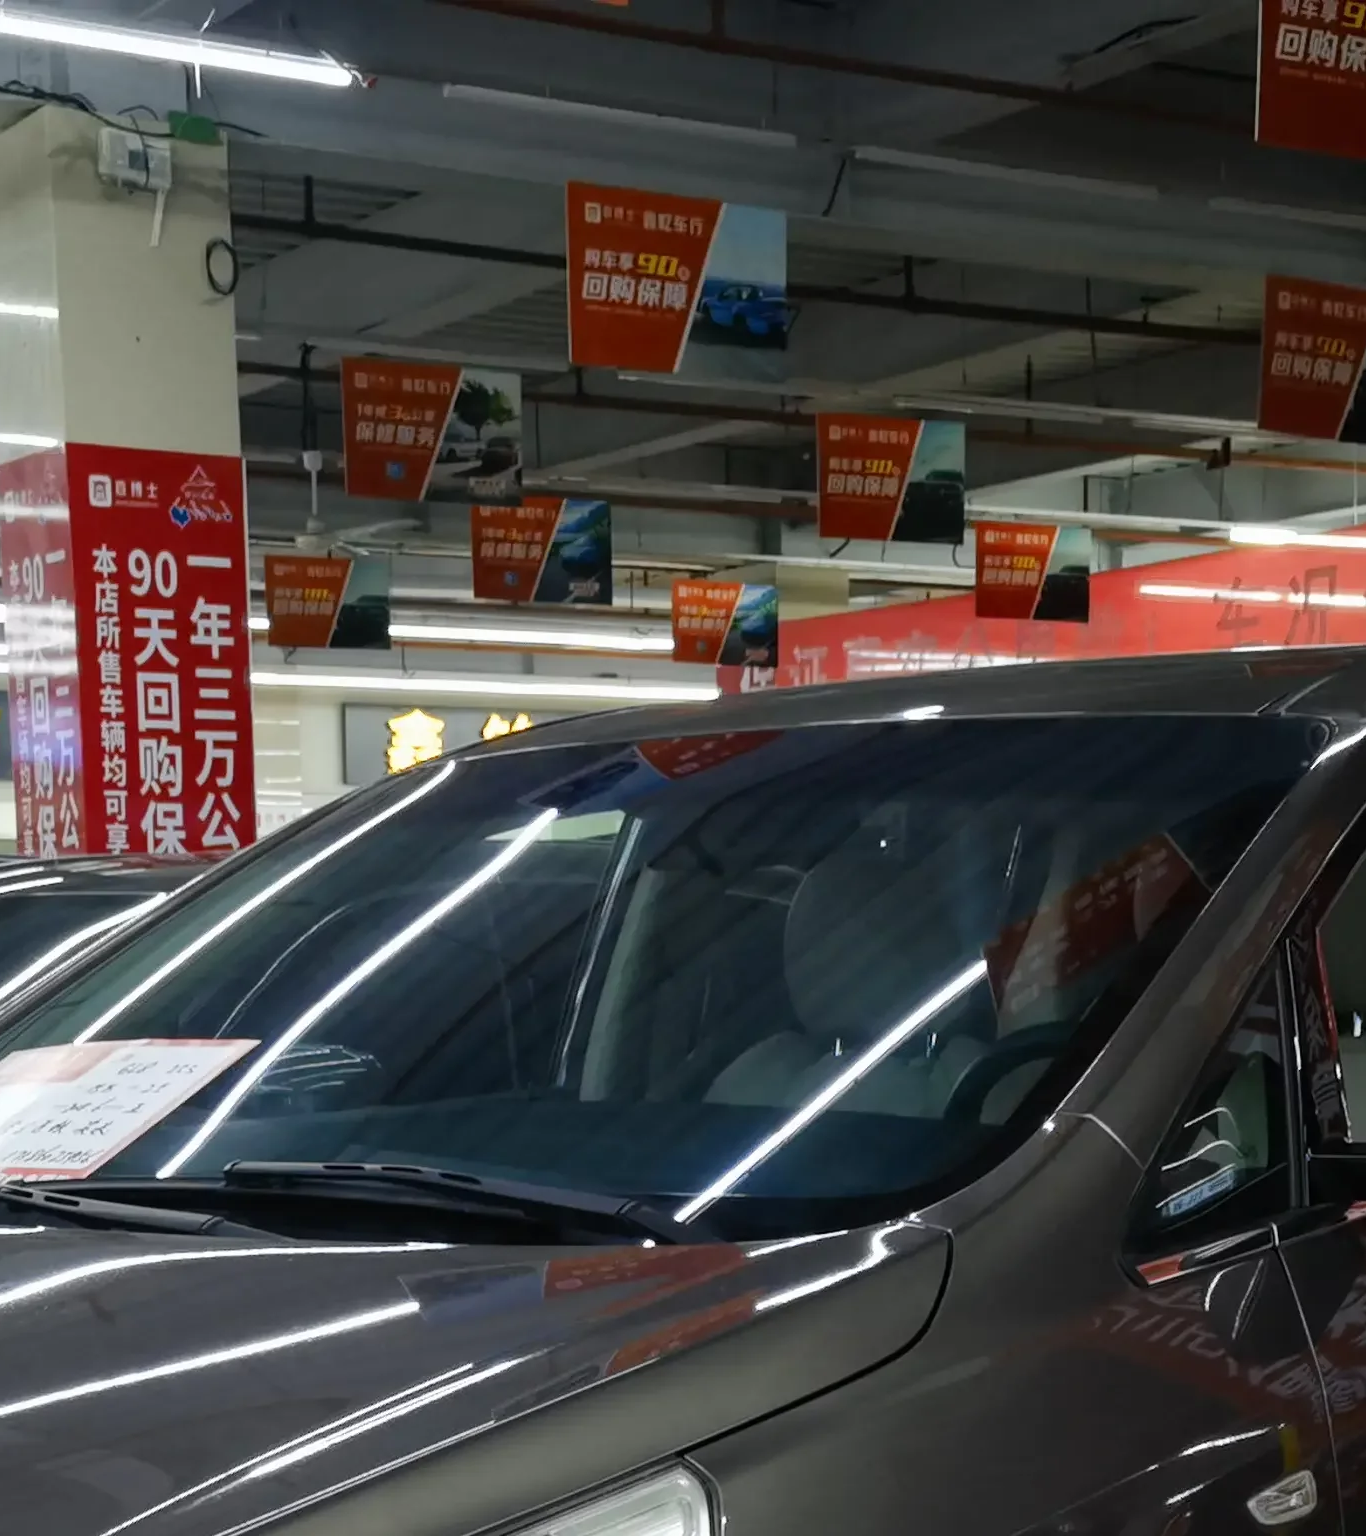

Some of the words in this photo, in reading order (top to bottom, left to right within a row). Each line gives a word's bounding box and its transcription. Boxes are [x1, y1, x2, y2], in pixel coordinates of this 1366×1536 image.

[582, 272, 688, 312] 回购保障
[92, 544, 130, 855] 本店所售车辆均可享
[127, 548, 186, 855] 90天回购保
[186, 554, 241, 850] 一年三万公
